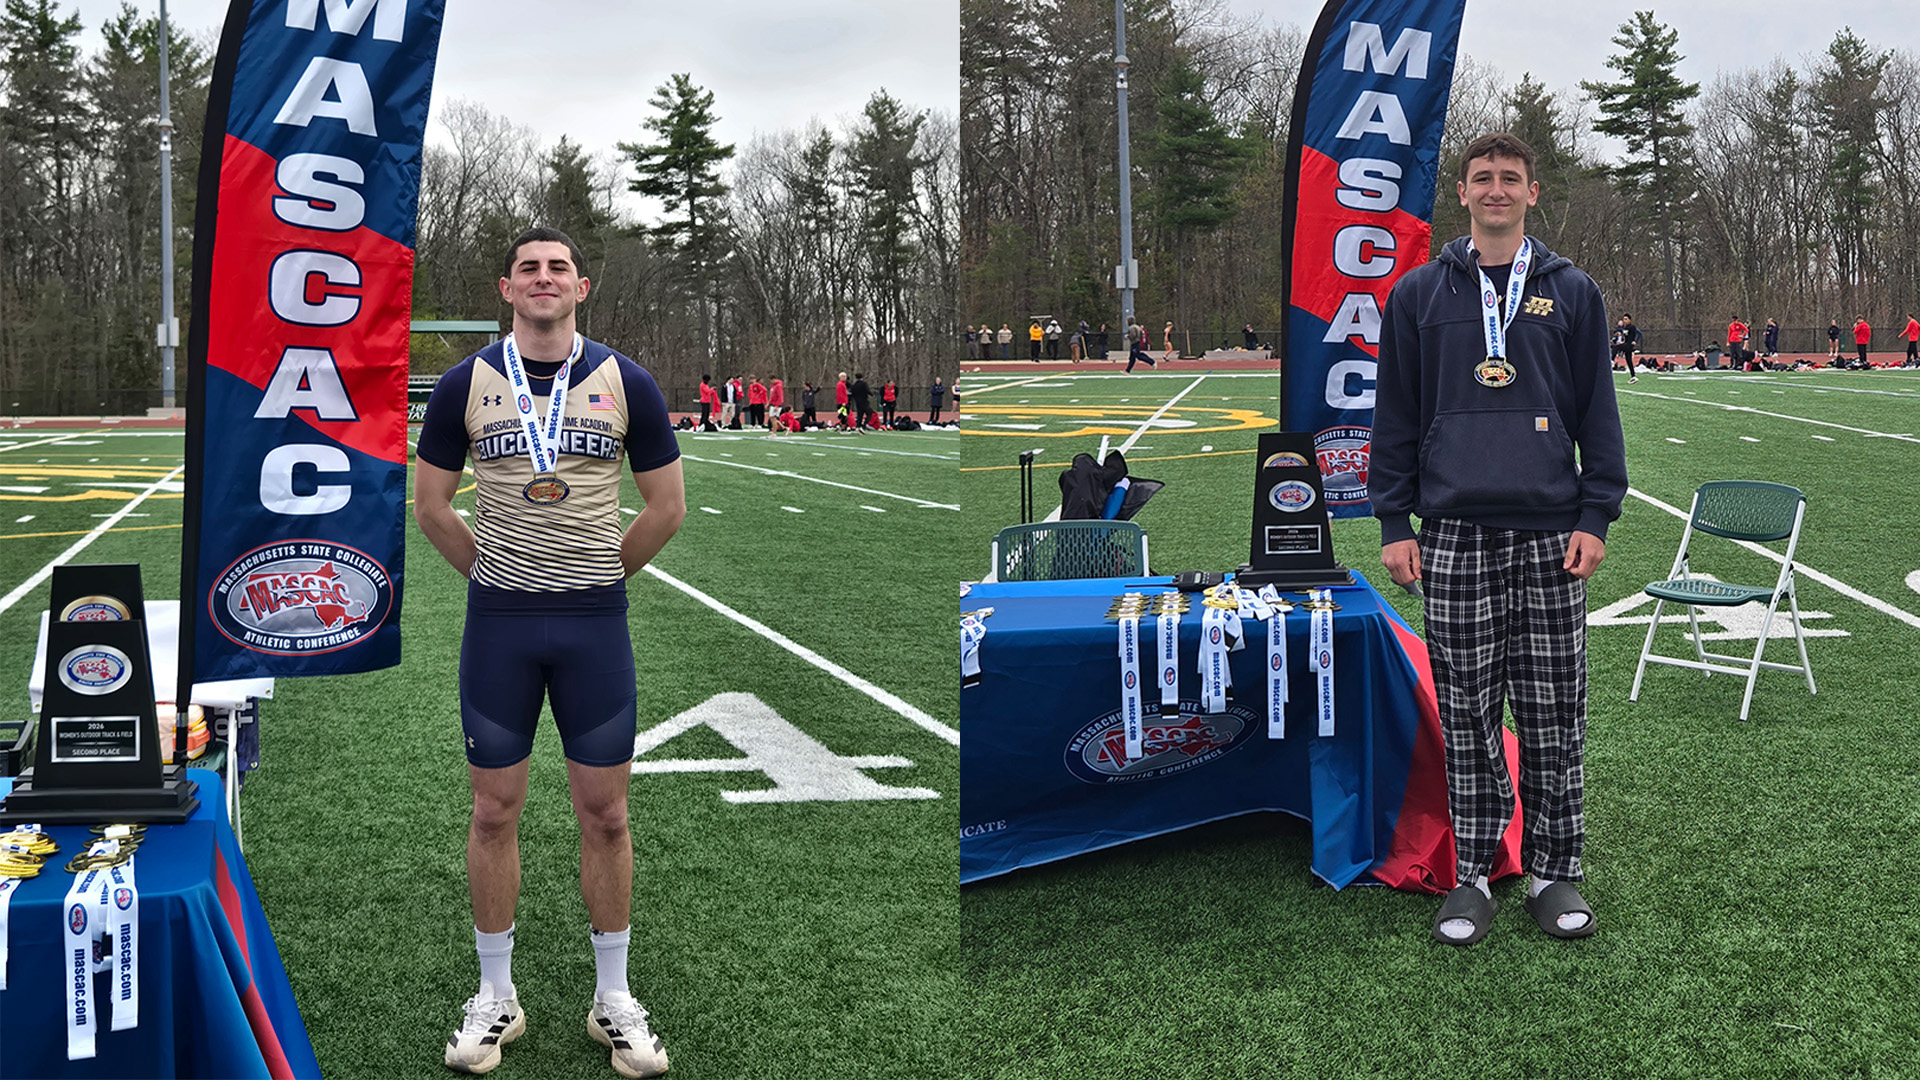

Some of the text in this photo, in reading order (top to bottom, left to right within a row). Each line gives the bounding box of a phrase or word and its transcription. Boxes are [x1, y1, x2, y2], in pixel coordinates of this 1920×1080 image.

[1321, 20, 1433, 410] MASCAC
[548, 389, 563, 440] mascac.com
[580, 418, 613, 433] ACADEMY
[475, 430, 622, 460] BUCCNEERS
[527, 420, 548, 473] mascac.com
[218, 544, 388, 594] MASSACHUSETTS STATE COLLEGIATE
[246, 574, 351, 621] MASCAC
[243, 627, 361, 650] ATHLETIC CONFERENCE
[1103, 726, 1218, 770] MSCAC
[1160, 748, 1224, 776] CONFERENCE
[121, 923, 132, 1001] mascac.com
[74, 948, 87, 1026] mascac.com
